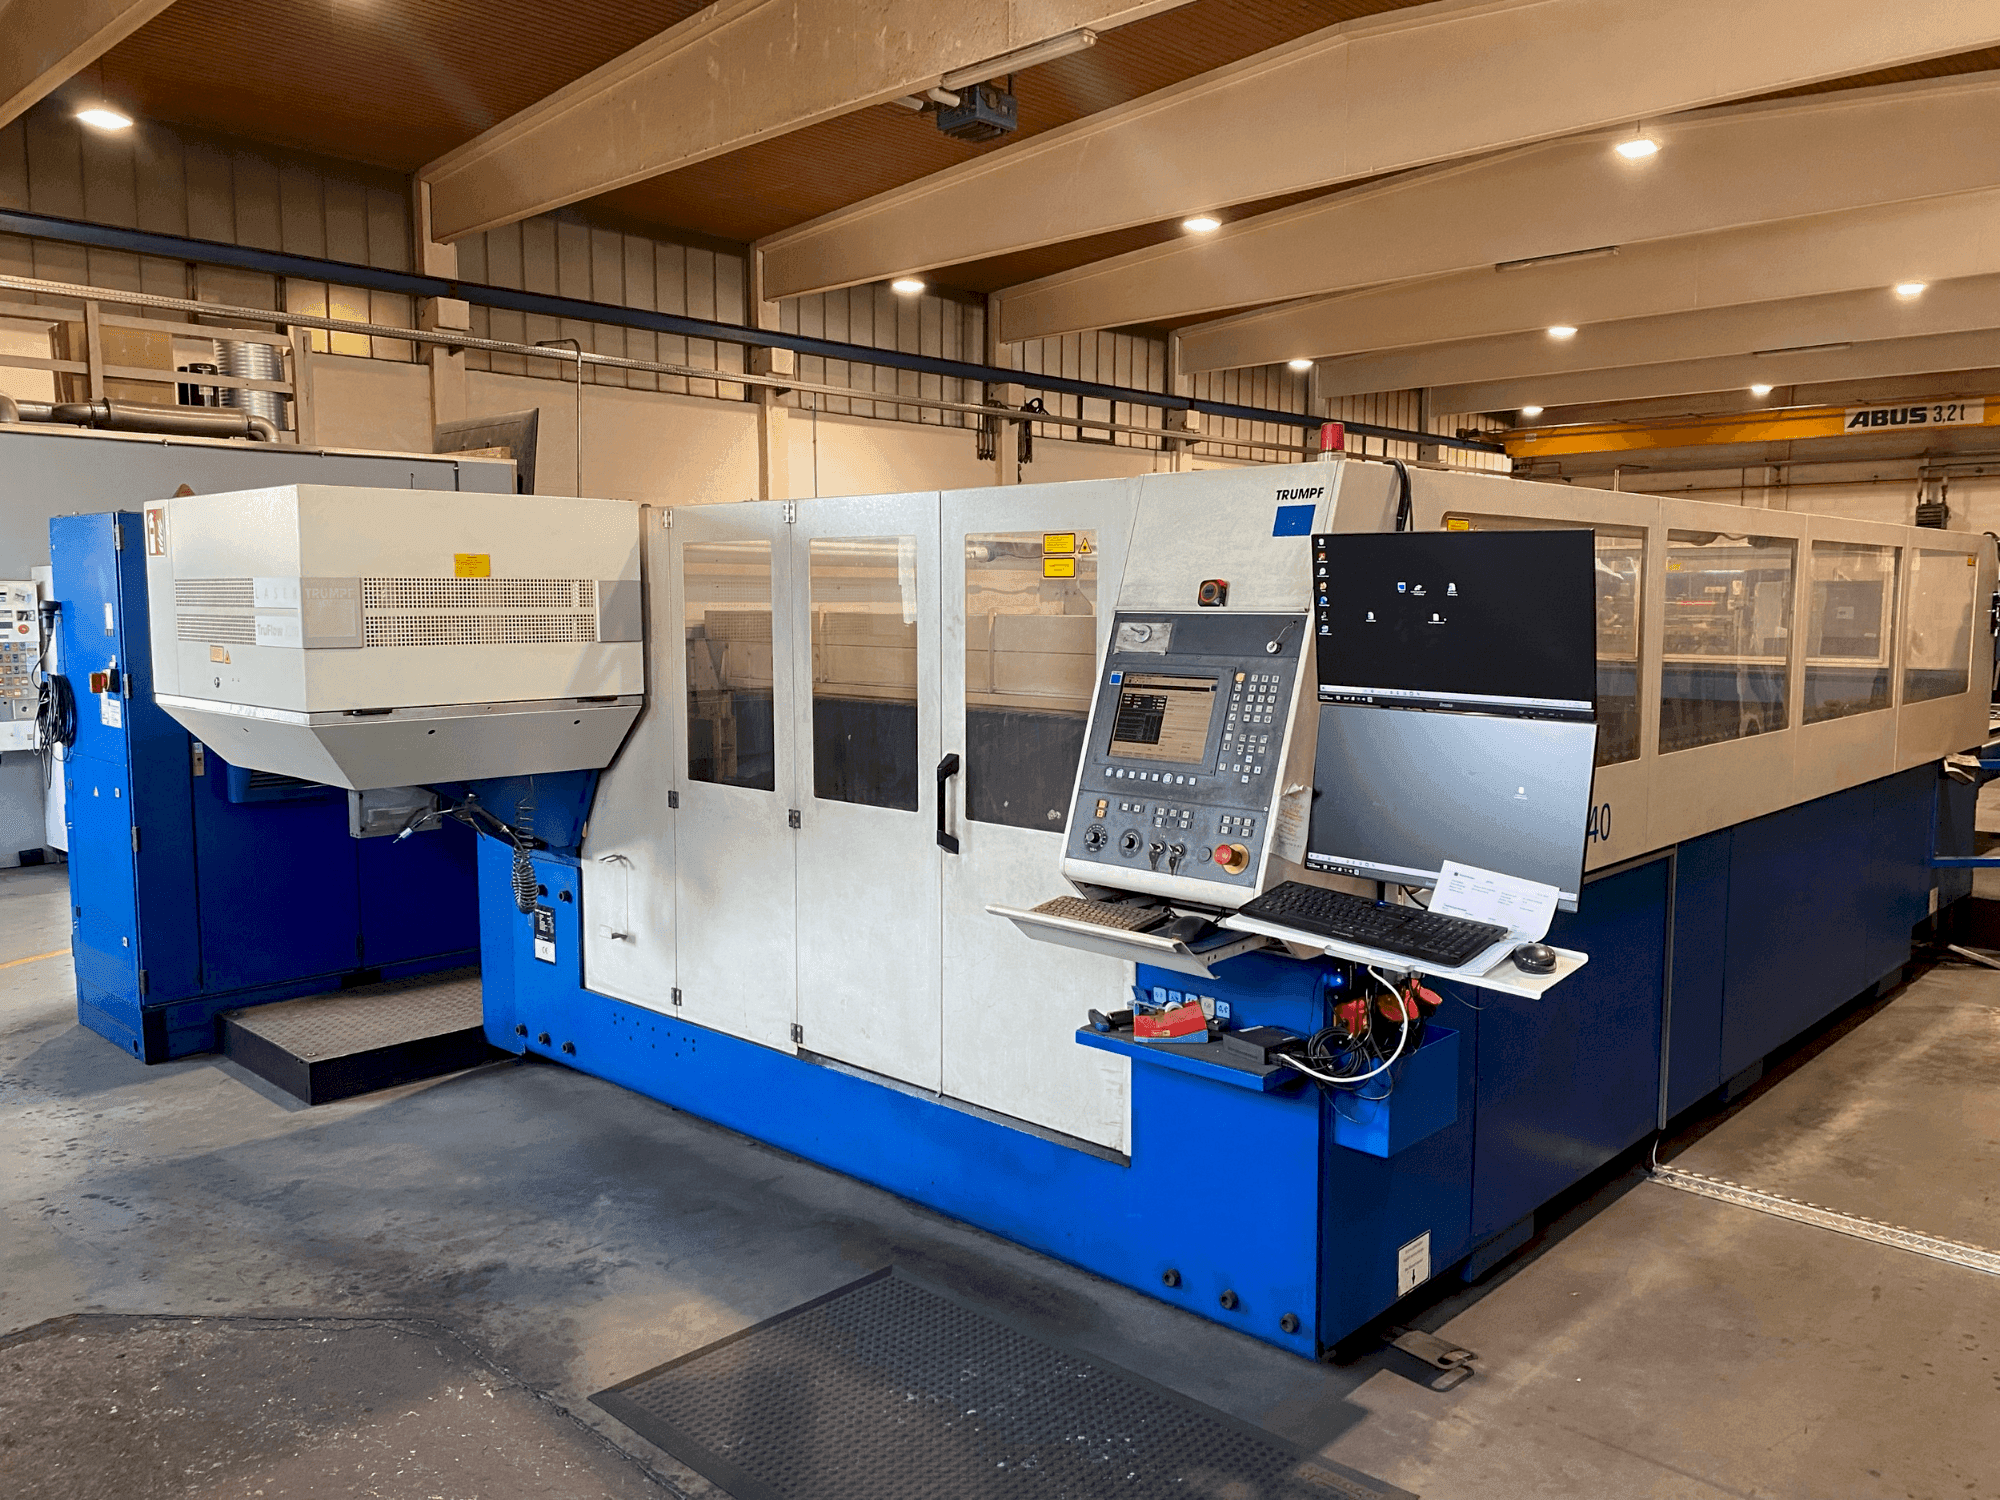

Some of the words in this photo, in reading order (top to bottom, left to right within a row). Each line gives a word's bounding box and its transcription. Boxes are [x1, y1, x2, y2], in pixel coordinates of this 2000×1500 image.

[1847, 406, 1928, 428] ABUS
[1276, 487, 1325, 501] TRUMPF
[304, 588, 355, 599] TRUMPF
